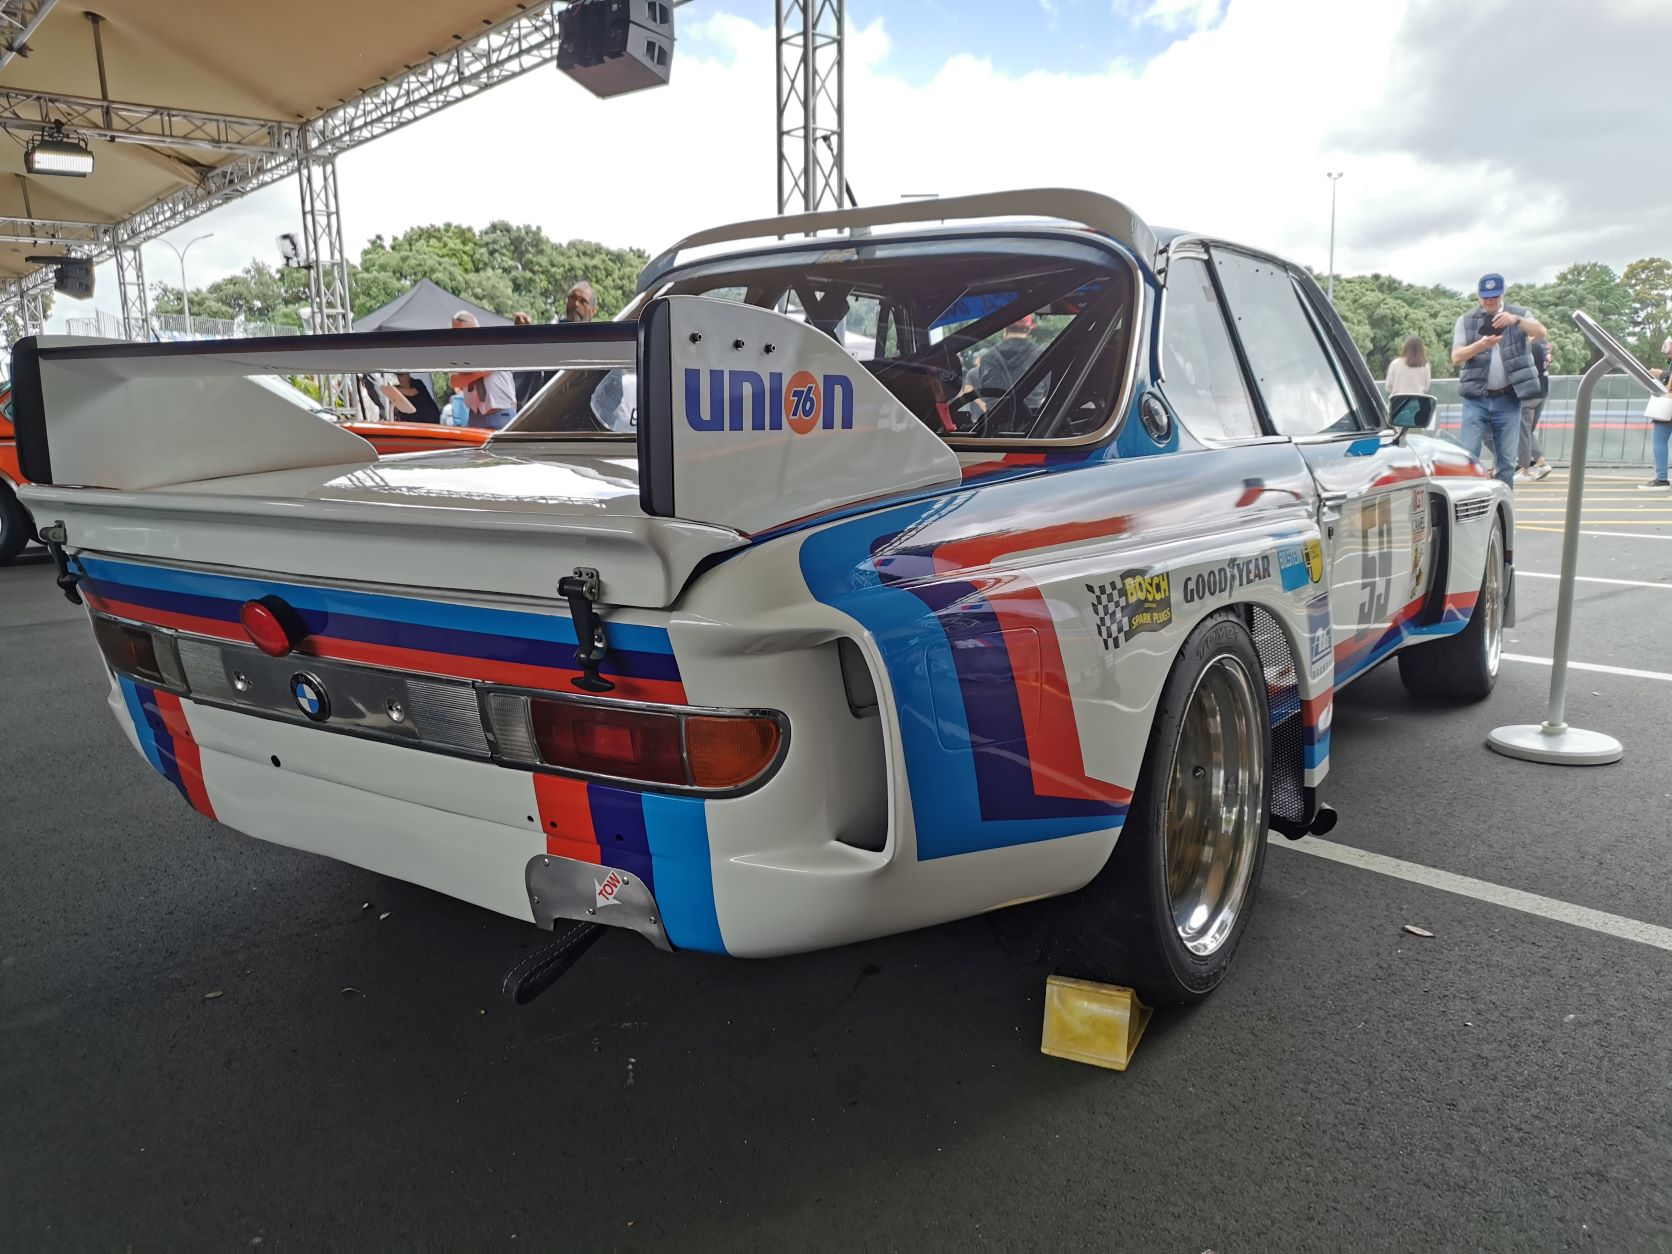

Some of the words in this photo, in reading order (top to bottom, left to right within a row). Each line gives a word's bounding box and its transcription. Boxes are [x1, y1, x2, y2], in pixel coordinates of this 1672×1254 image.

[685, 368, 853, 435] UNION
[790, 384, 816, 419] 76
[1124, 573, 1169, 604] BOSCH
[1131, 613, 1152, 630] SPARK
[1153, 608, 1170, 625] PLUGS
[598, 872, 621, 900] TOW
